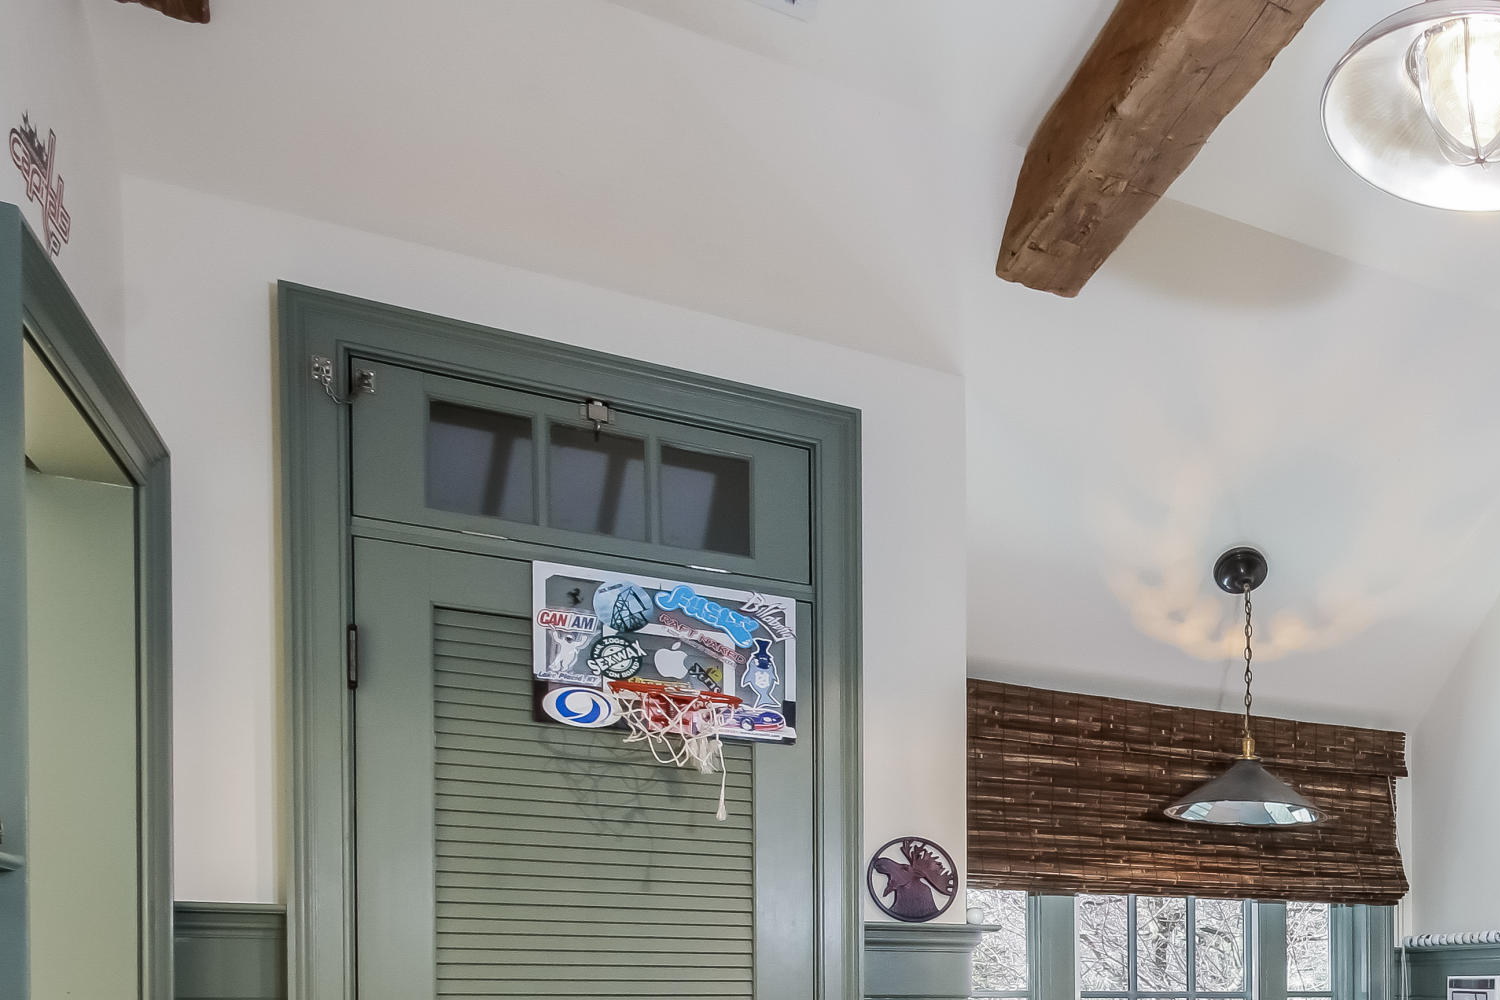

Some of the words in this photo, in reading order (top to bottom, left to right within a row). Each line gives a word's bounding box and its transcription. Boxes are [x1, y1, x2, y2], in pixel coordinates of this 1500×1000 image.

[540, 611, 568, 627] CAN
[571, 616, 594, 630] AM
[659, 613, 698, 637] RAFT
[699, 634, 747, 664] NAKED
